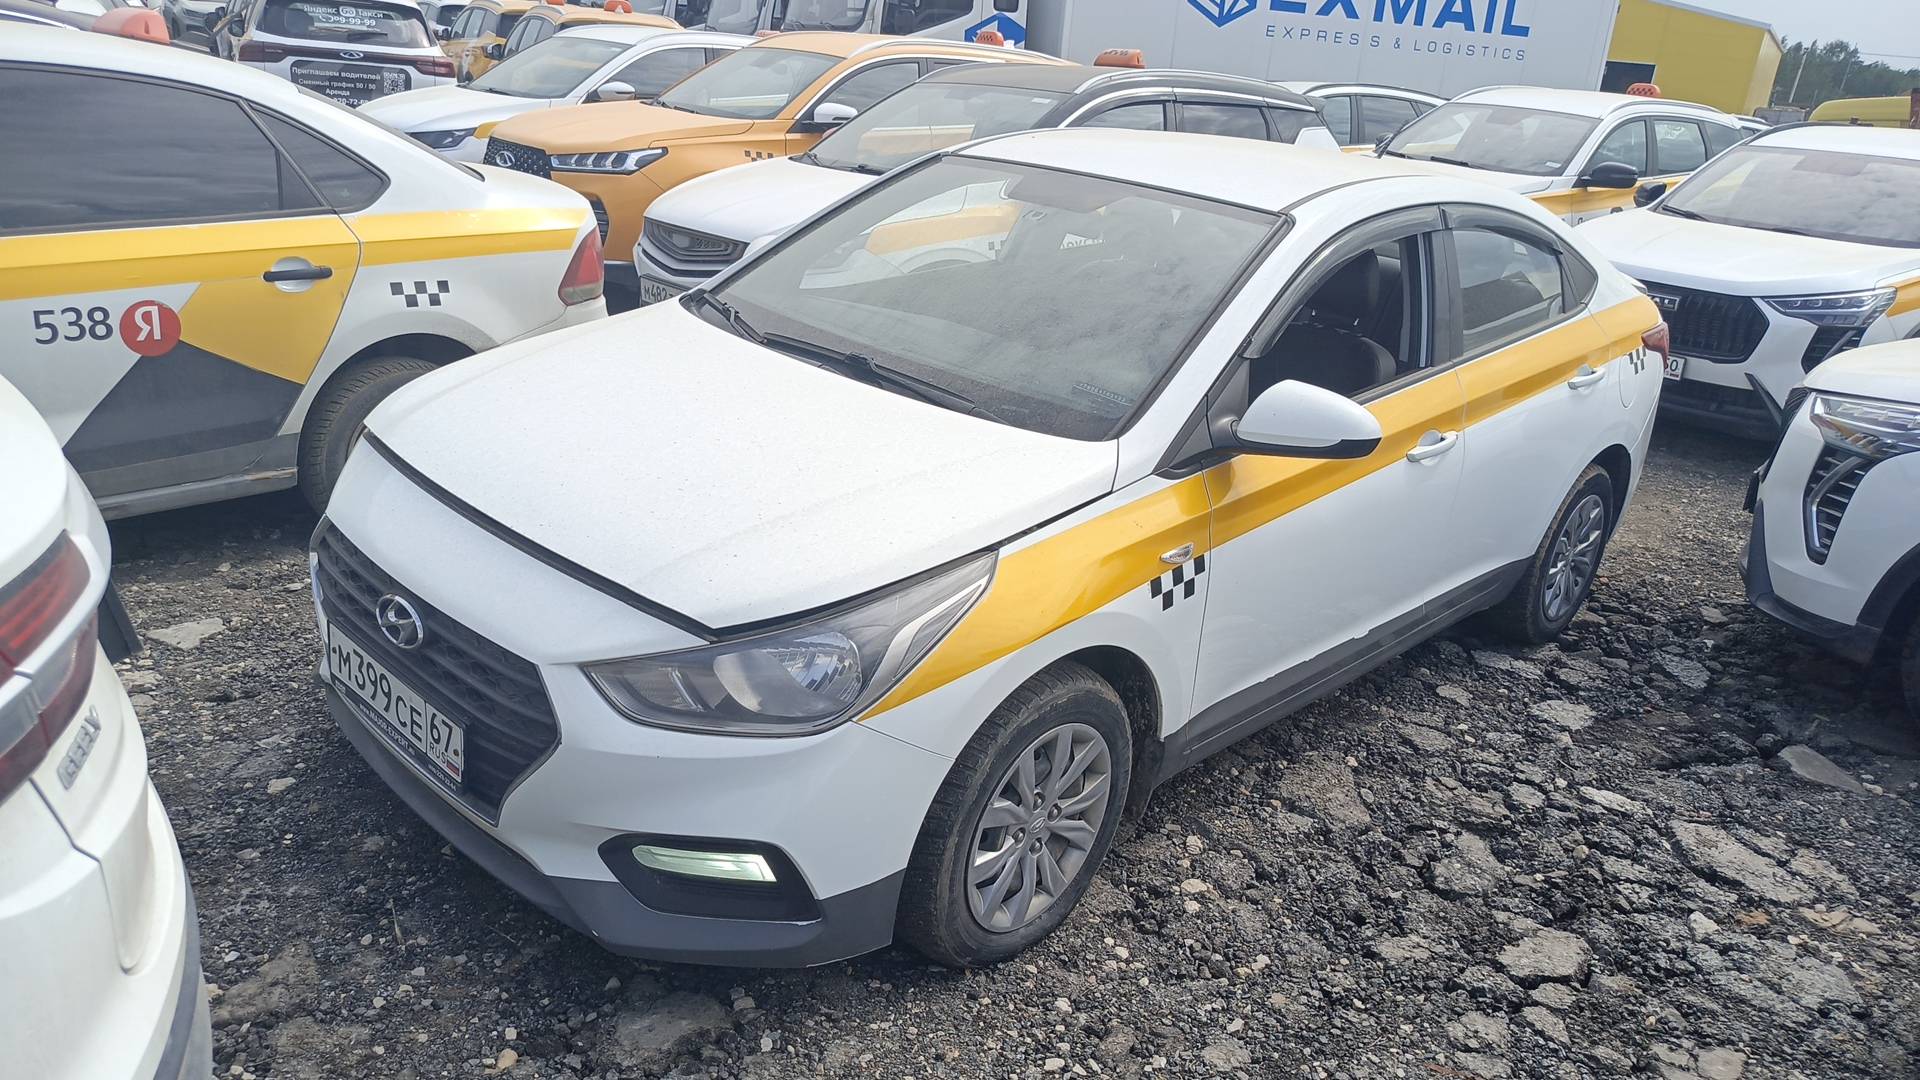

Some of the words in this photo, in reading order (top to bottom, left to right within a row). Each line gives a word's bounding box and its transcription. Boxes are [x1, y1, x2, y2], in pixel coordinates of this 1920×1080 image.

[303, 5, 338, 14] Яндекс
[358, 8, 383, 18] Такси
[1265, 25, 1381, 48] EXPRESS
[1393, 37, 1401, 50] &
[1413, 39, 1526, 61] LOGISTICS
[292, 66, 339, 77] Приглашаем
[341, 72, 381, 81] водителей
[325, 88, 350, 97] Аренда
[33, 306, 114, 345] 538
[133, 305, 162, 341] Я
[429, 712, 453, 753] 67
[429, 742, 447, 765] RUS
